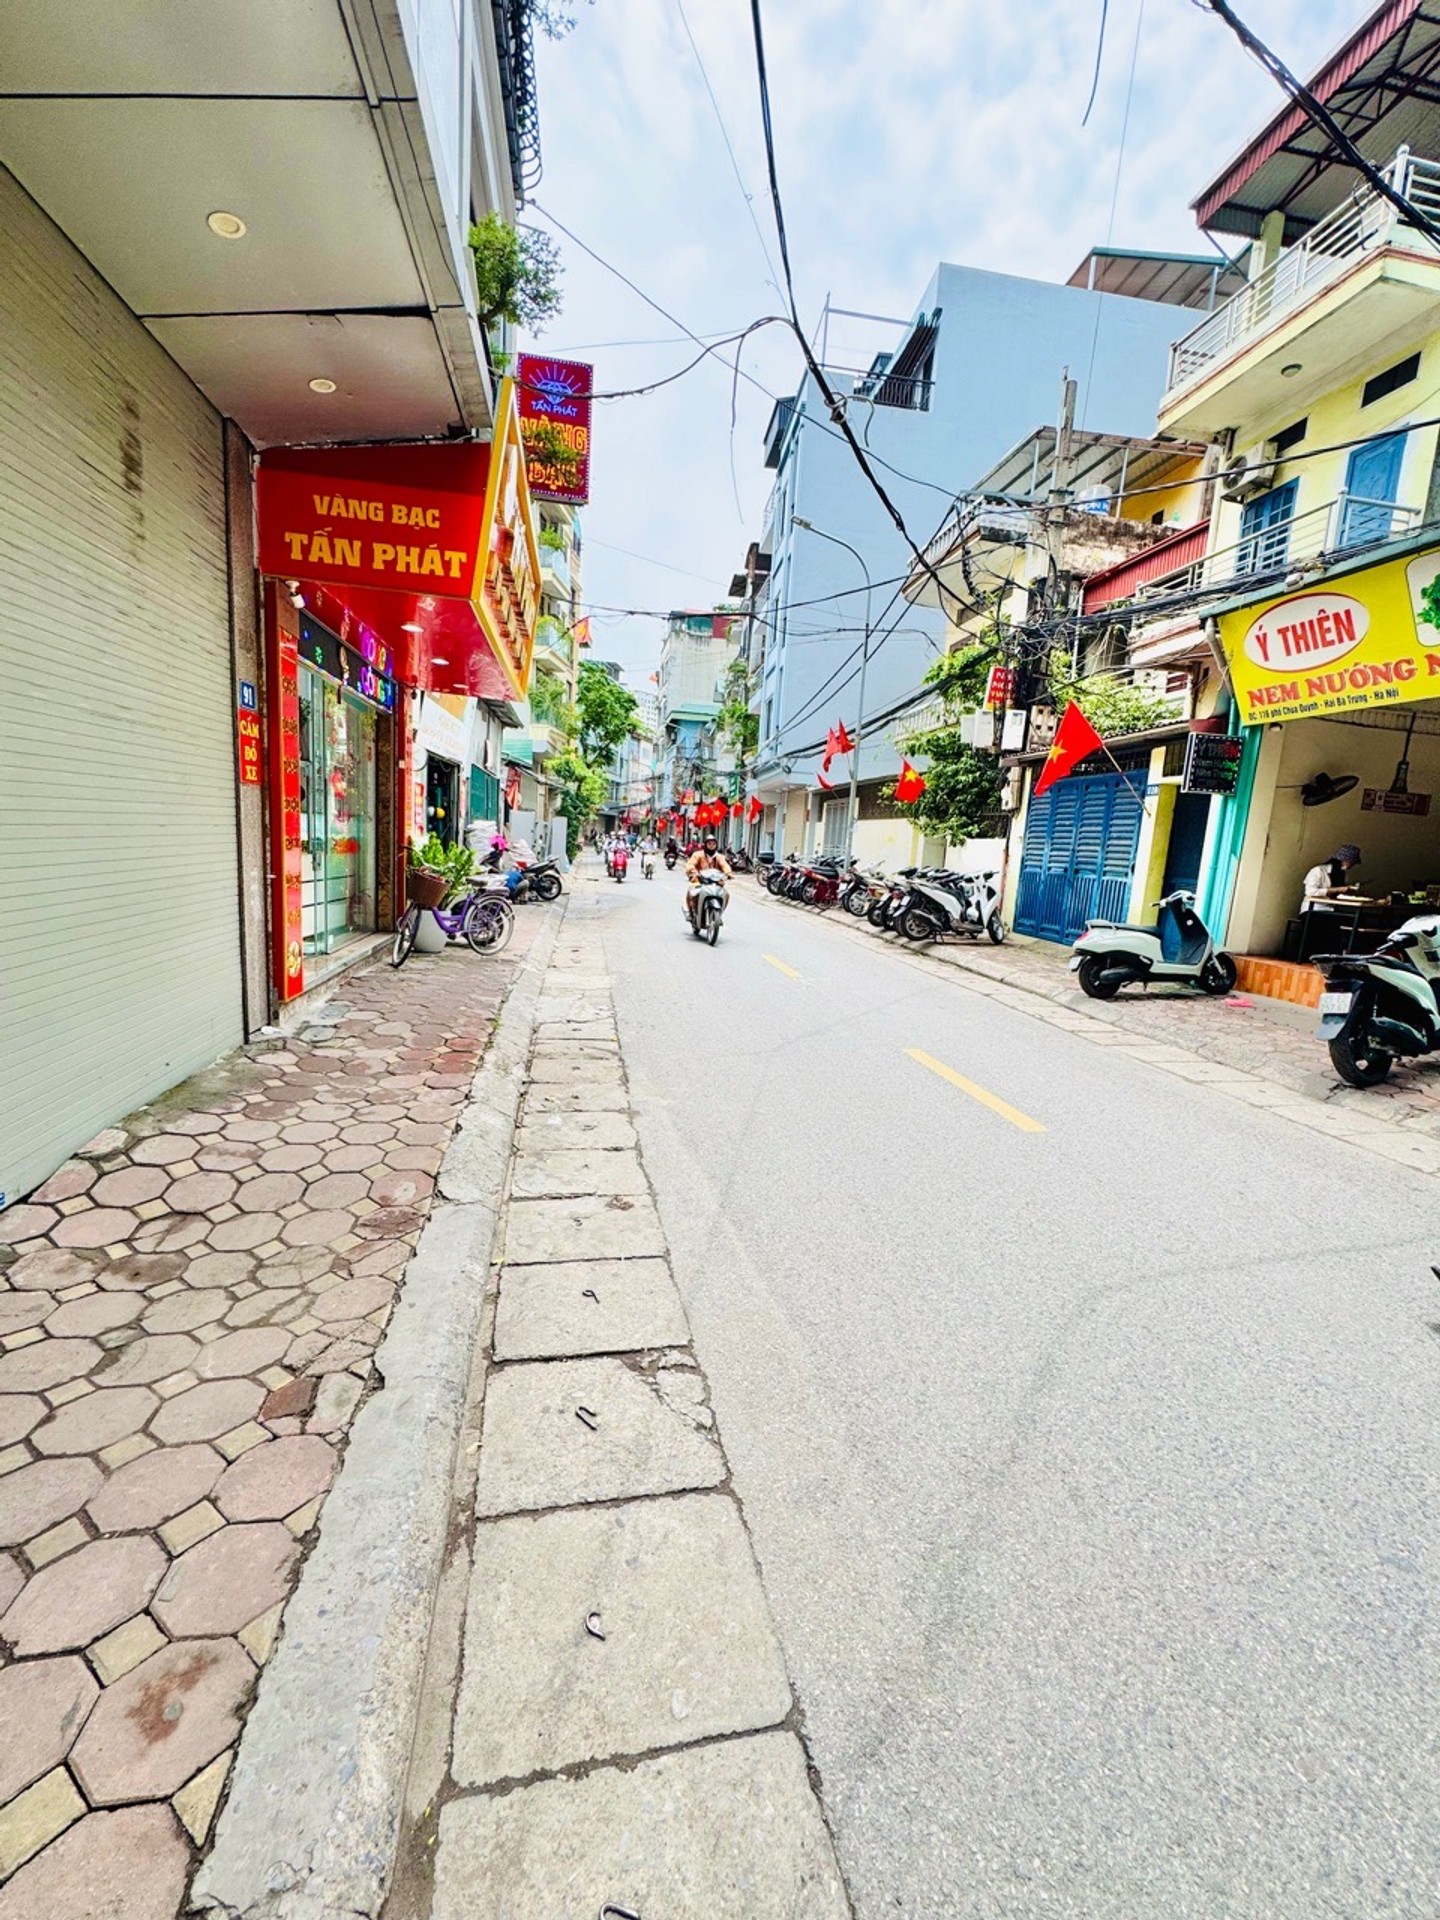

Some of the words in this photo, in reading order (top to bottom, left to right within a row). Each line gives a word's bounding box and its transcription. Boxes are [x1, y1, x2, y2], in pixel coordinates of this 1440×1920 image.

[531, 399, 551, 413] TẤN
[553, 404, 578, 417] PHÁT
[313, 493, 385, 522] VÀNG
[391, 503, 440, 530] BẠC
[284, 526, 362, 568] TẤN
[372, 543, 467, 578] PHÁT
[1255, 624, 1270, 662] Ý
[1277, 608, 1357, 657] THIÊN
[243, 686, 253, 706] 91
[1247, 681, 1301, 708] NEM
[1305, 658, 1419, 697] NƯỚNG
[245, 765, 258, 780] XE
